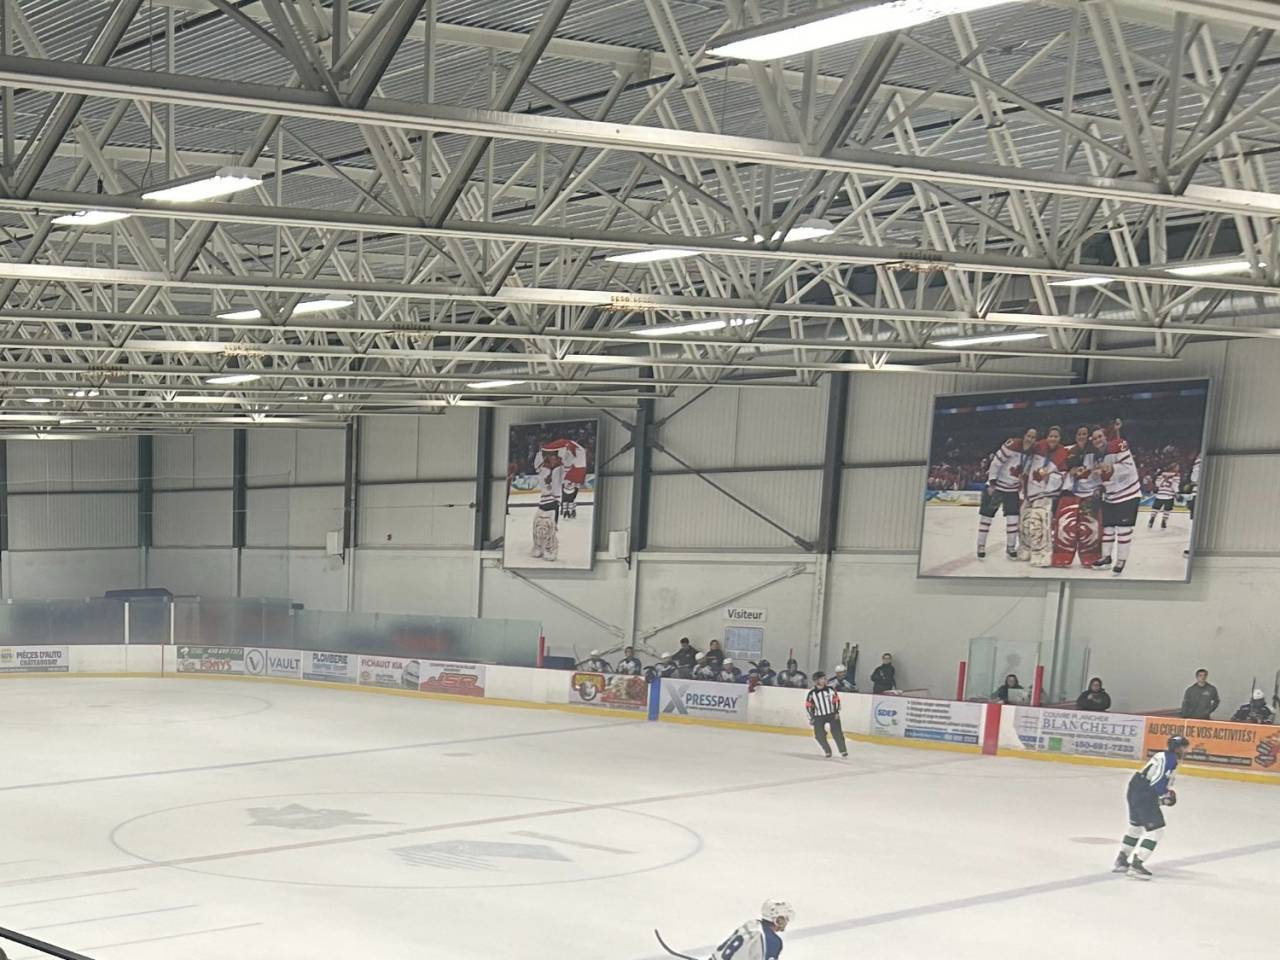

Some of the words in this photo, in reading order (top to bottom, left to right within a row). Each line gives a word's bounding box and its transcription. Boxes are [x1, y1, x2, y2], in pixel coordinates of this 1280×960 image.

[727, 608, 763, 620] Visiteur
[269, 656, 301, 670] VAULT
[312, 653, 348, 665] PLOMBERIE
[685, 692, 739, 710] PRESSPAY
[1042, 718, 1138, 738] BLANCHETTE
[1148, 723, 1159, 735] AU
[1186, 725, 1196, 738] DE
[1196, 726, 1212, 739] VOS
[1212, 728, 1253, 743] ACTIVITÉS
